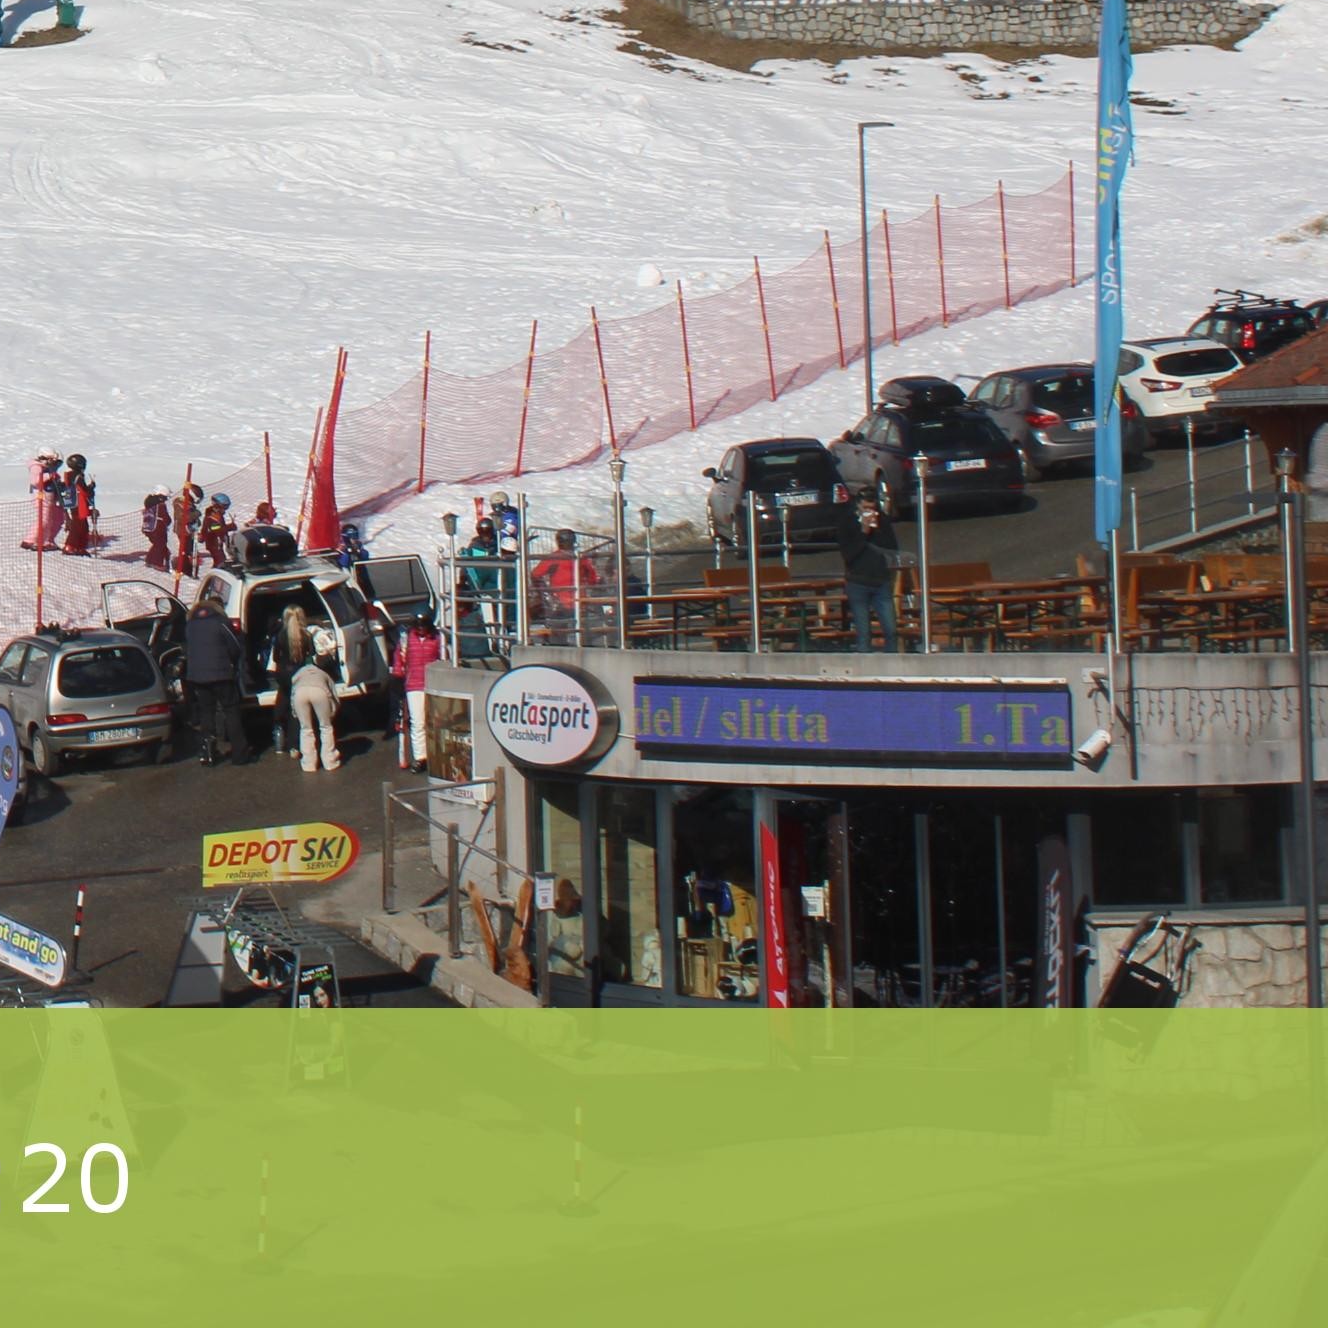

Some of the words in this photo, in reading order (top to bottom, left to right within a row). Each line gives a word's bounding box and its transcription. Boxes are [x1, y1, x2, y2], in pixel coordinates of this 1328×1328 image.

[491, 691, 590, 743] rentasport
[719, 696, 831, 744] slitta
[507, 728, 547, 745] Gitschberg
[208, 839, 298, 868] DEPOT
[300, 835, 347, 863] SKI
[305, 859, 340, 871] SERVICE
[11, 931, 40, 954] and
[39, 944, 58, 965] go
